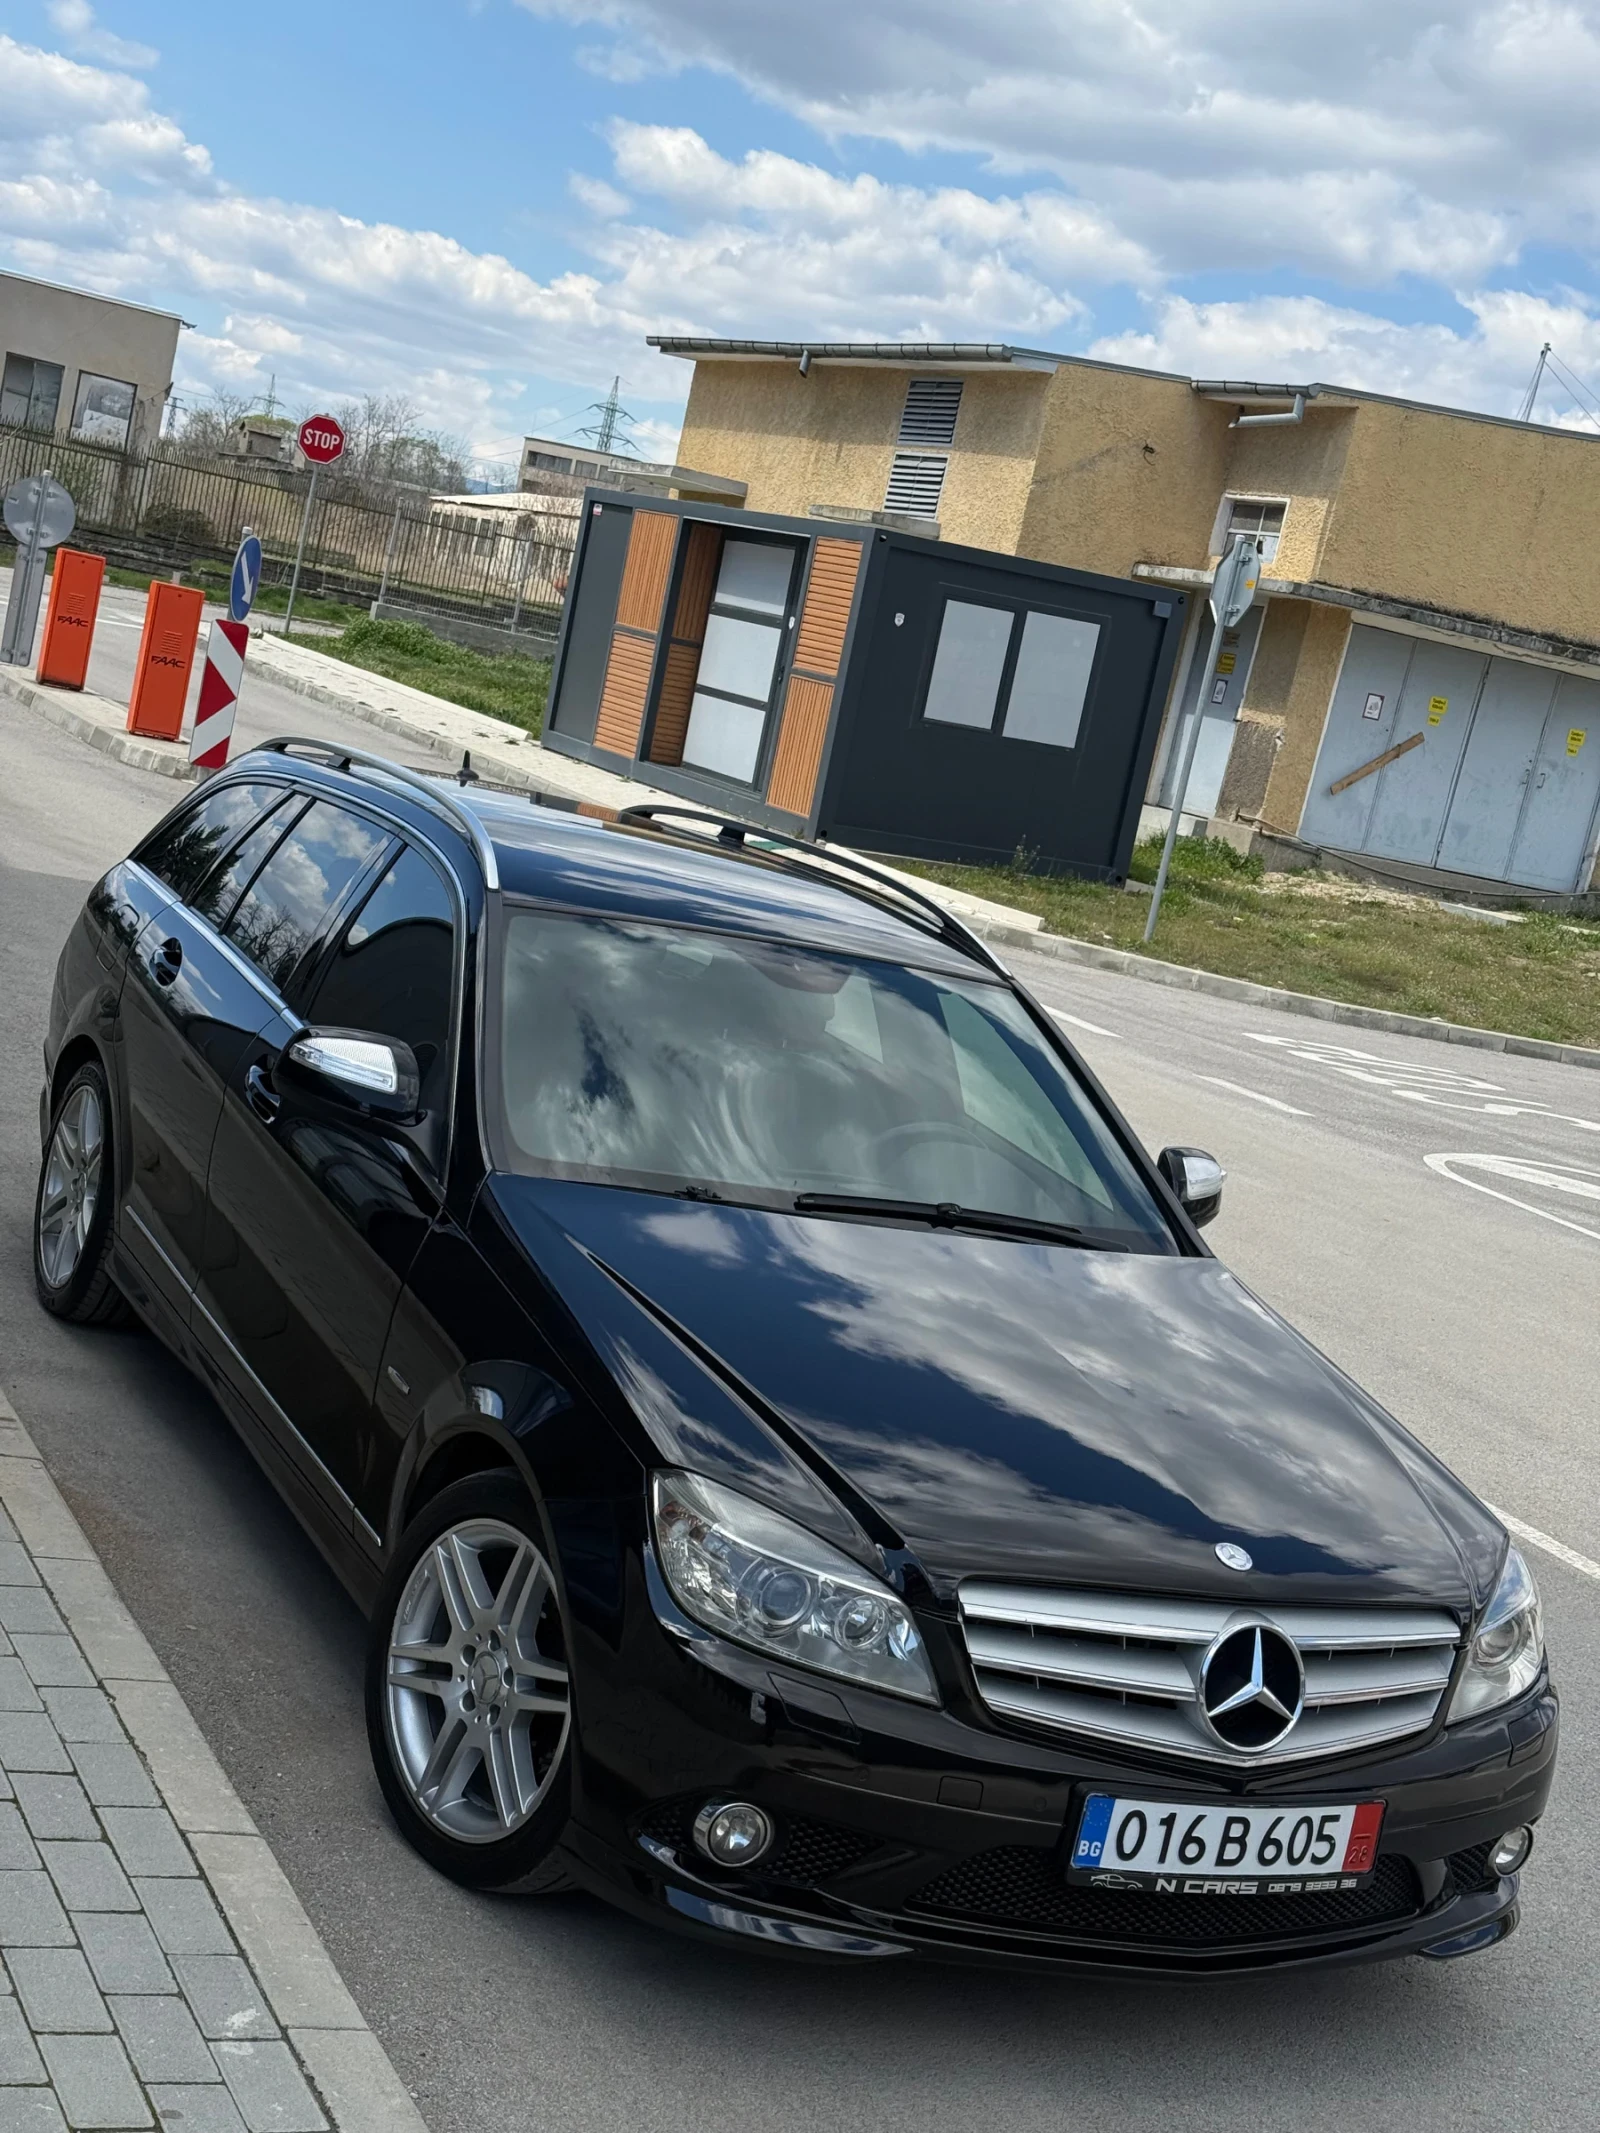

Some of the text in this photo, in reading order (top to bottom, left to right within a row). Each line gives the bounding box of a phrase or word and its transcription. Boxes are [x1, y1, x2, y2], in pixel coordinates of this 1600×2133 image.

[303, 428, 340, 451] STOP
[57, 615, 89, 628] FAAC
[151, 655, 186, 669] FAAC
[1078, 1839, 1102, 1857] BG
[1155, 1878, 1177, 1893] N
[1183, 1880, 1259, 1895] CARS
